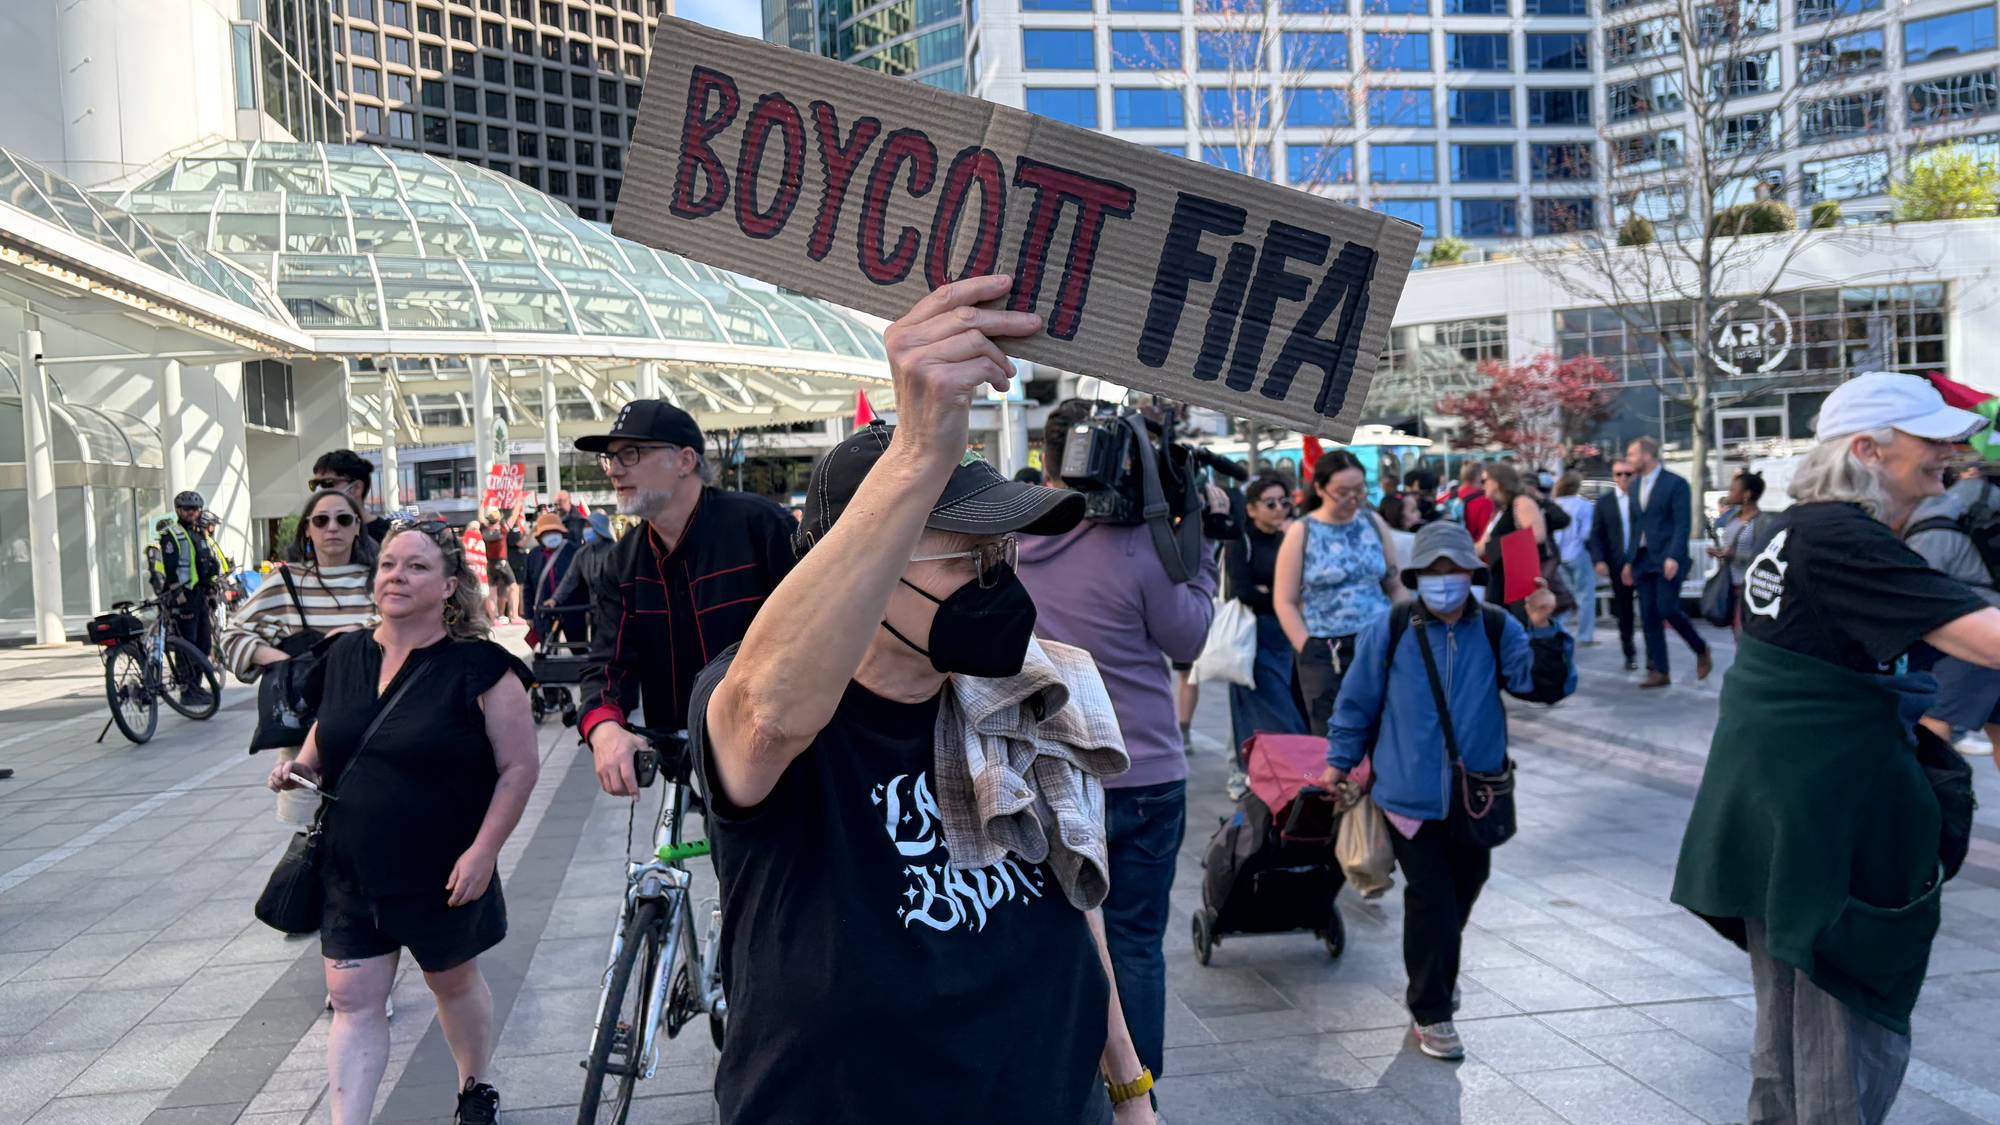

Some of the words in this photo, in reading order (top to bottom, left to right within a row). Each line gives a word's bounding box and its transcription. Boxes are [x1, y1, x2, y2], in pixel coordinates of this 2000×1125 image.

[669, 64, 1137, 341] BOYCOTT
[1136, 191, 1379, 418] FIFA
[1718, 322, 1776, 348] ARC
[501, 464, 519, 476] NO
[497, 490, 515, 500] NO
